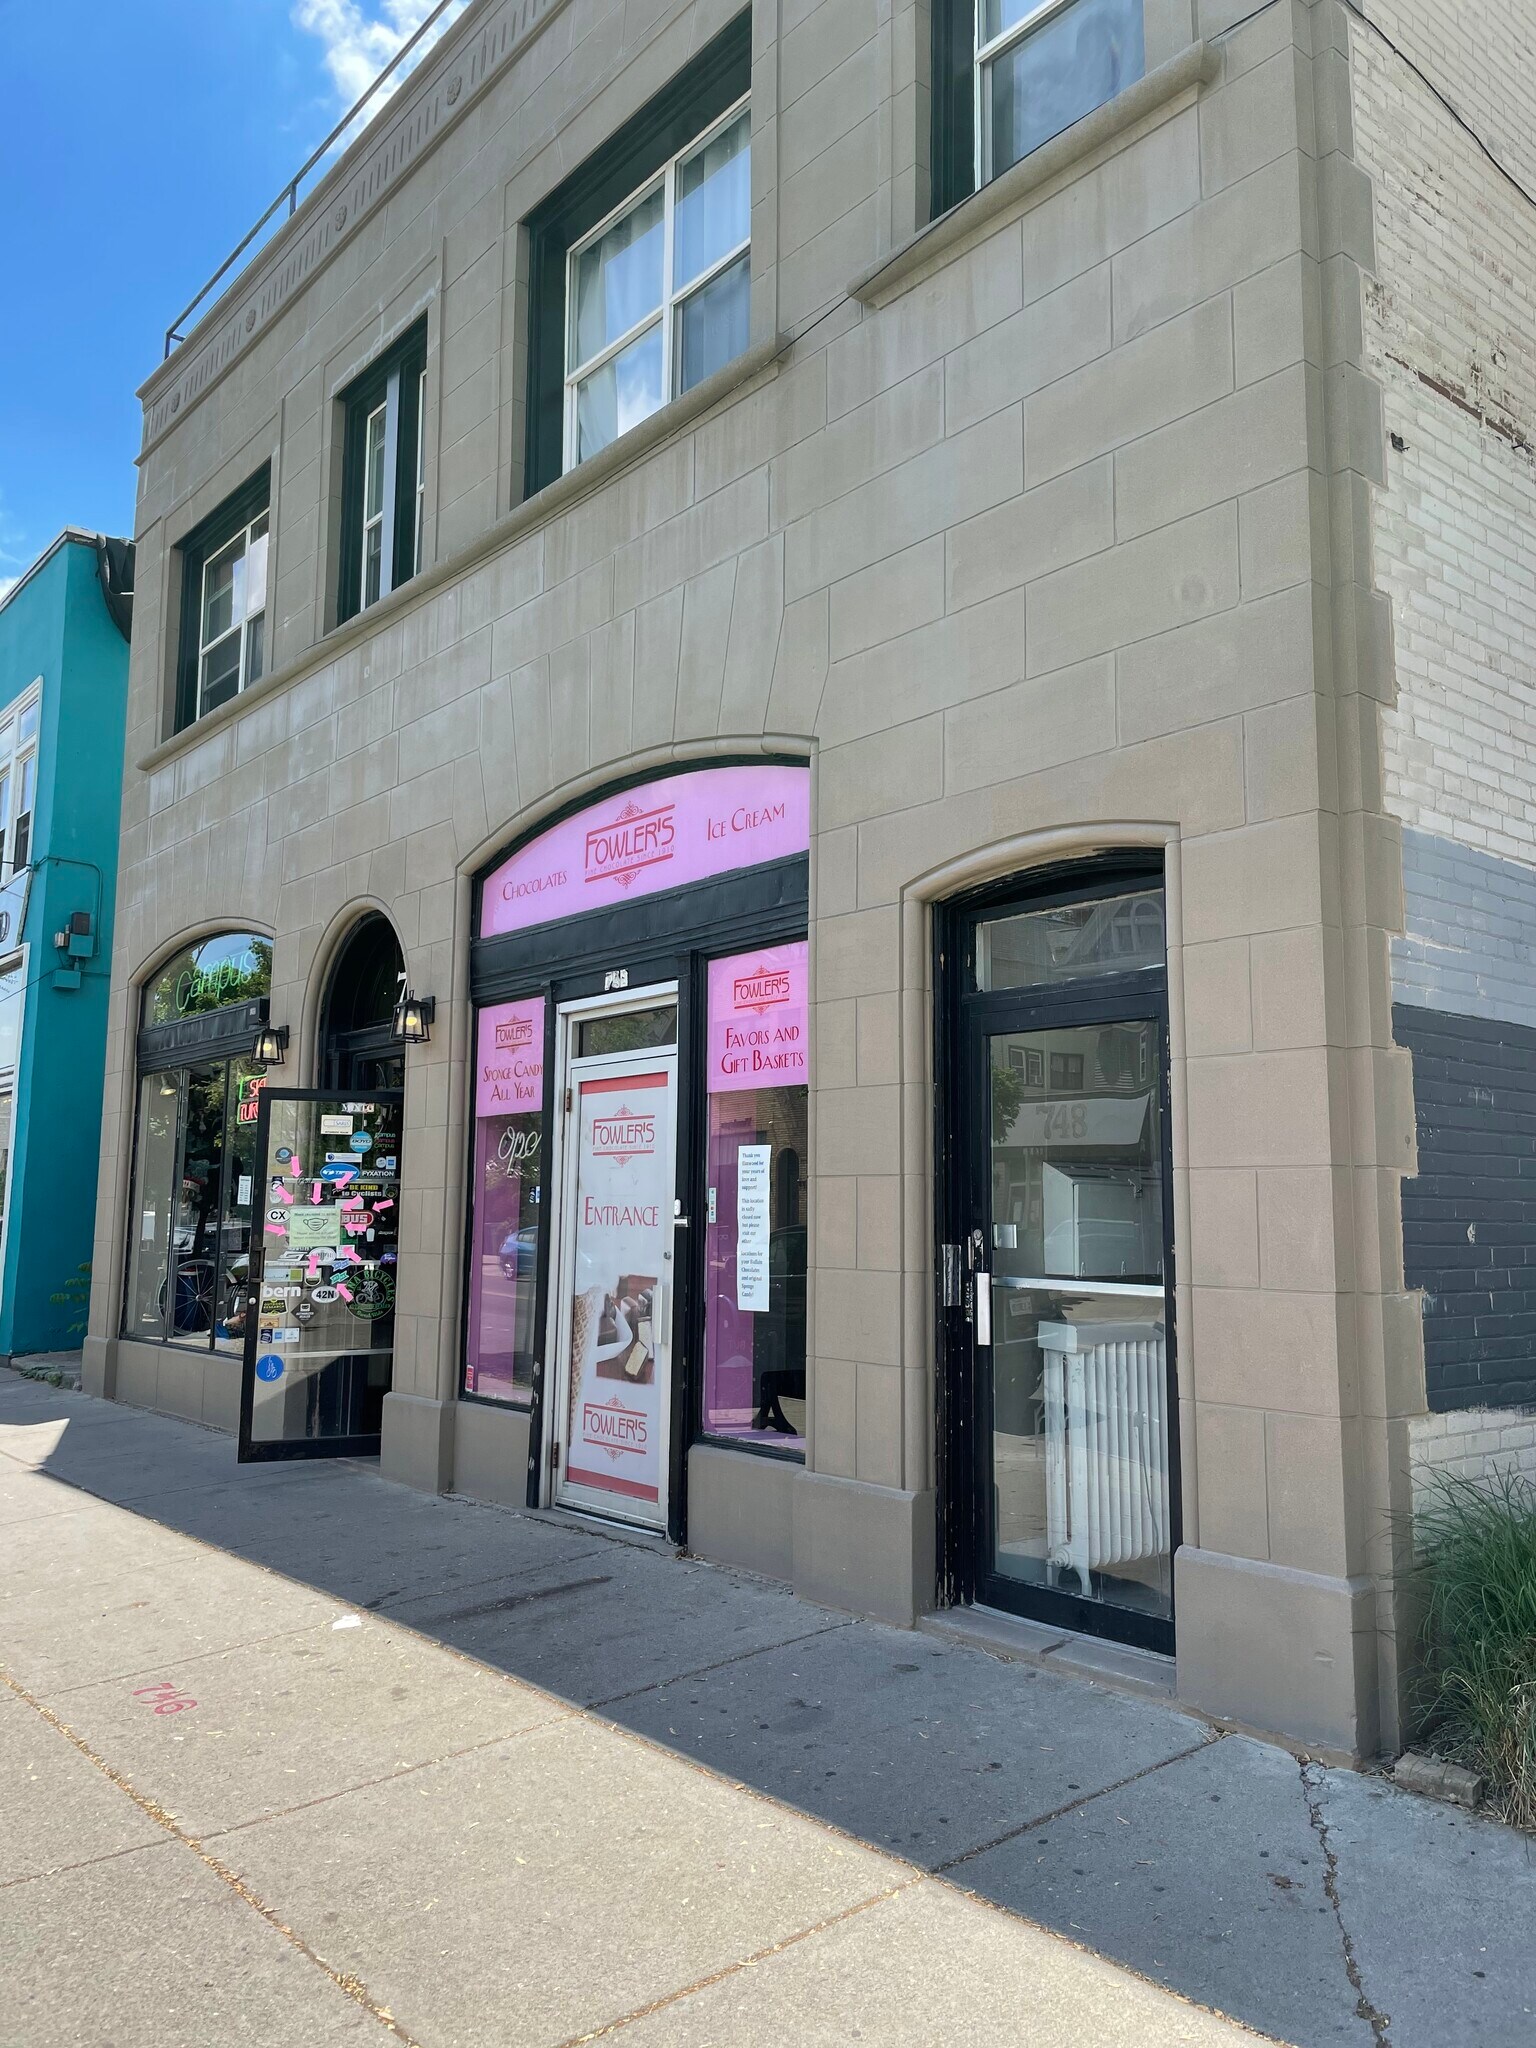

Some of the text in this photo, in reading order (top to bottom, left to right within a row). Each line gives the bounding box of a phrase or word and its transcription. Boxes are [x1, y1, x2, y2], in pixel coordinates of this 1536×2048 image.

[707, 802, 785, 841] ICE CREAM
[585, 814, 675, 869] FOWLER'S
[502, 870, 568, 901] CHOCOLATES
[176, 950, 257, 1011] Campus
[734, 976, 790, 1001] FOWLER'S
[495, 1024, 533, 1043] FOWLER'S
[725, 1025, 800, 1049] FAVORS AND
[483, 1061, 543, 1082] SPONGE CANDY
[721, 1050, 804, 1074] GIFT BASKETS
[490, 1082, 535, 1101] ALL YEAR
[593, 1120, 655, 1146] FOWLER'S
[1035, 1103, 1088, 1139] 748
[270, 1211, 286, 1220] CX
[584, 1196, 660, 1227] ENTRANCE
[263, 1285, 301, 1297] bern
[316, 1290, 335, 1299] 42N
[583, 1404, 647, 1442] FOWLER'S
